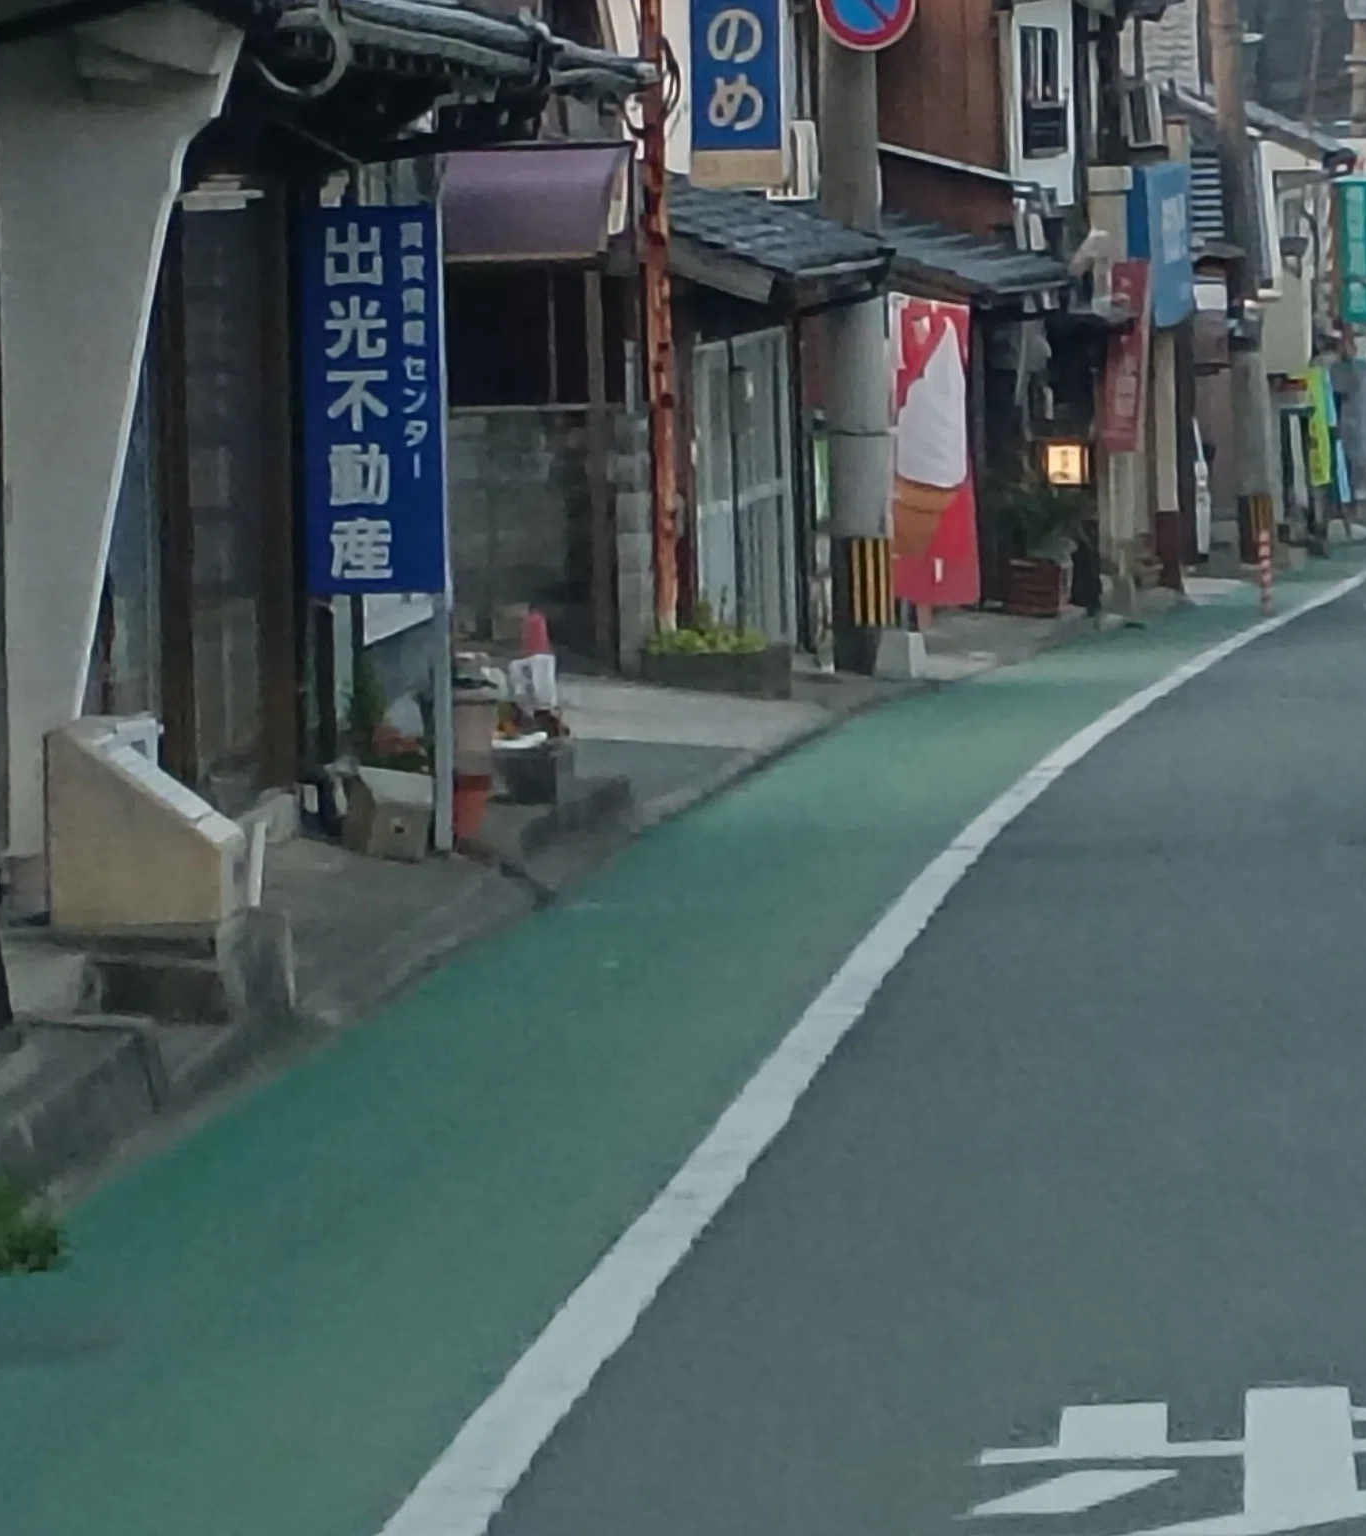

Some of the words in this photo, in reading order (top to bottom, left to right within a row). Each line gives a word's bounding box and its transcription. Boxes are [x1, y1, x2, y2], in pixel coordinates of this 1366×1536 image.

[323, 221, 393, 580] 出光不動産
